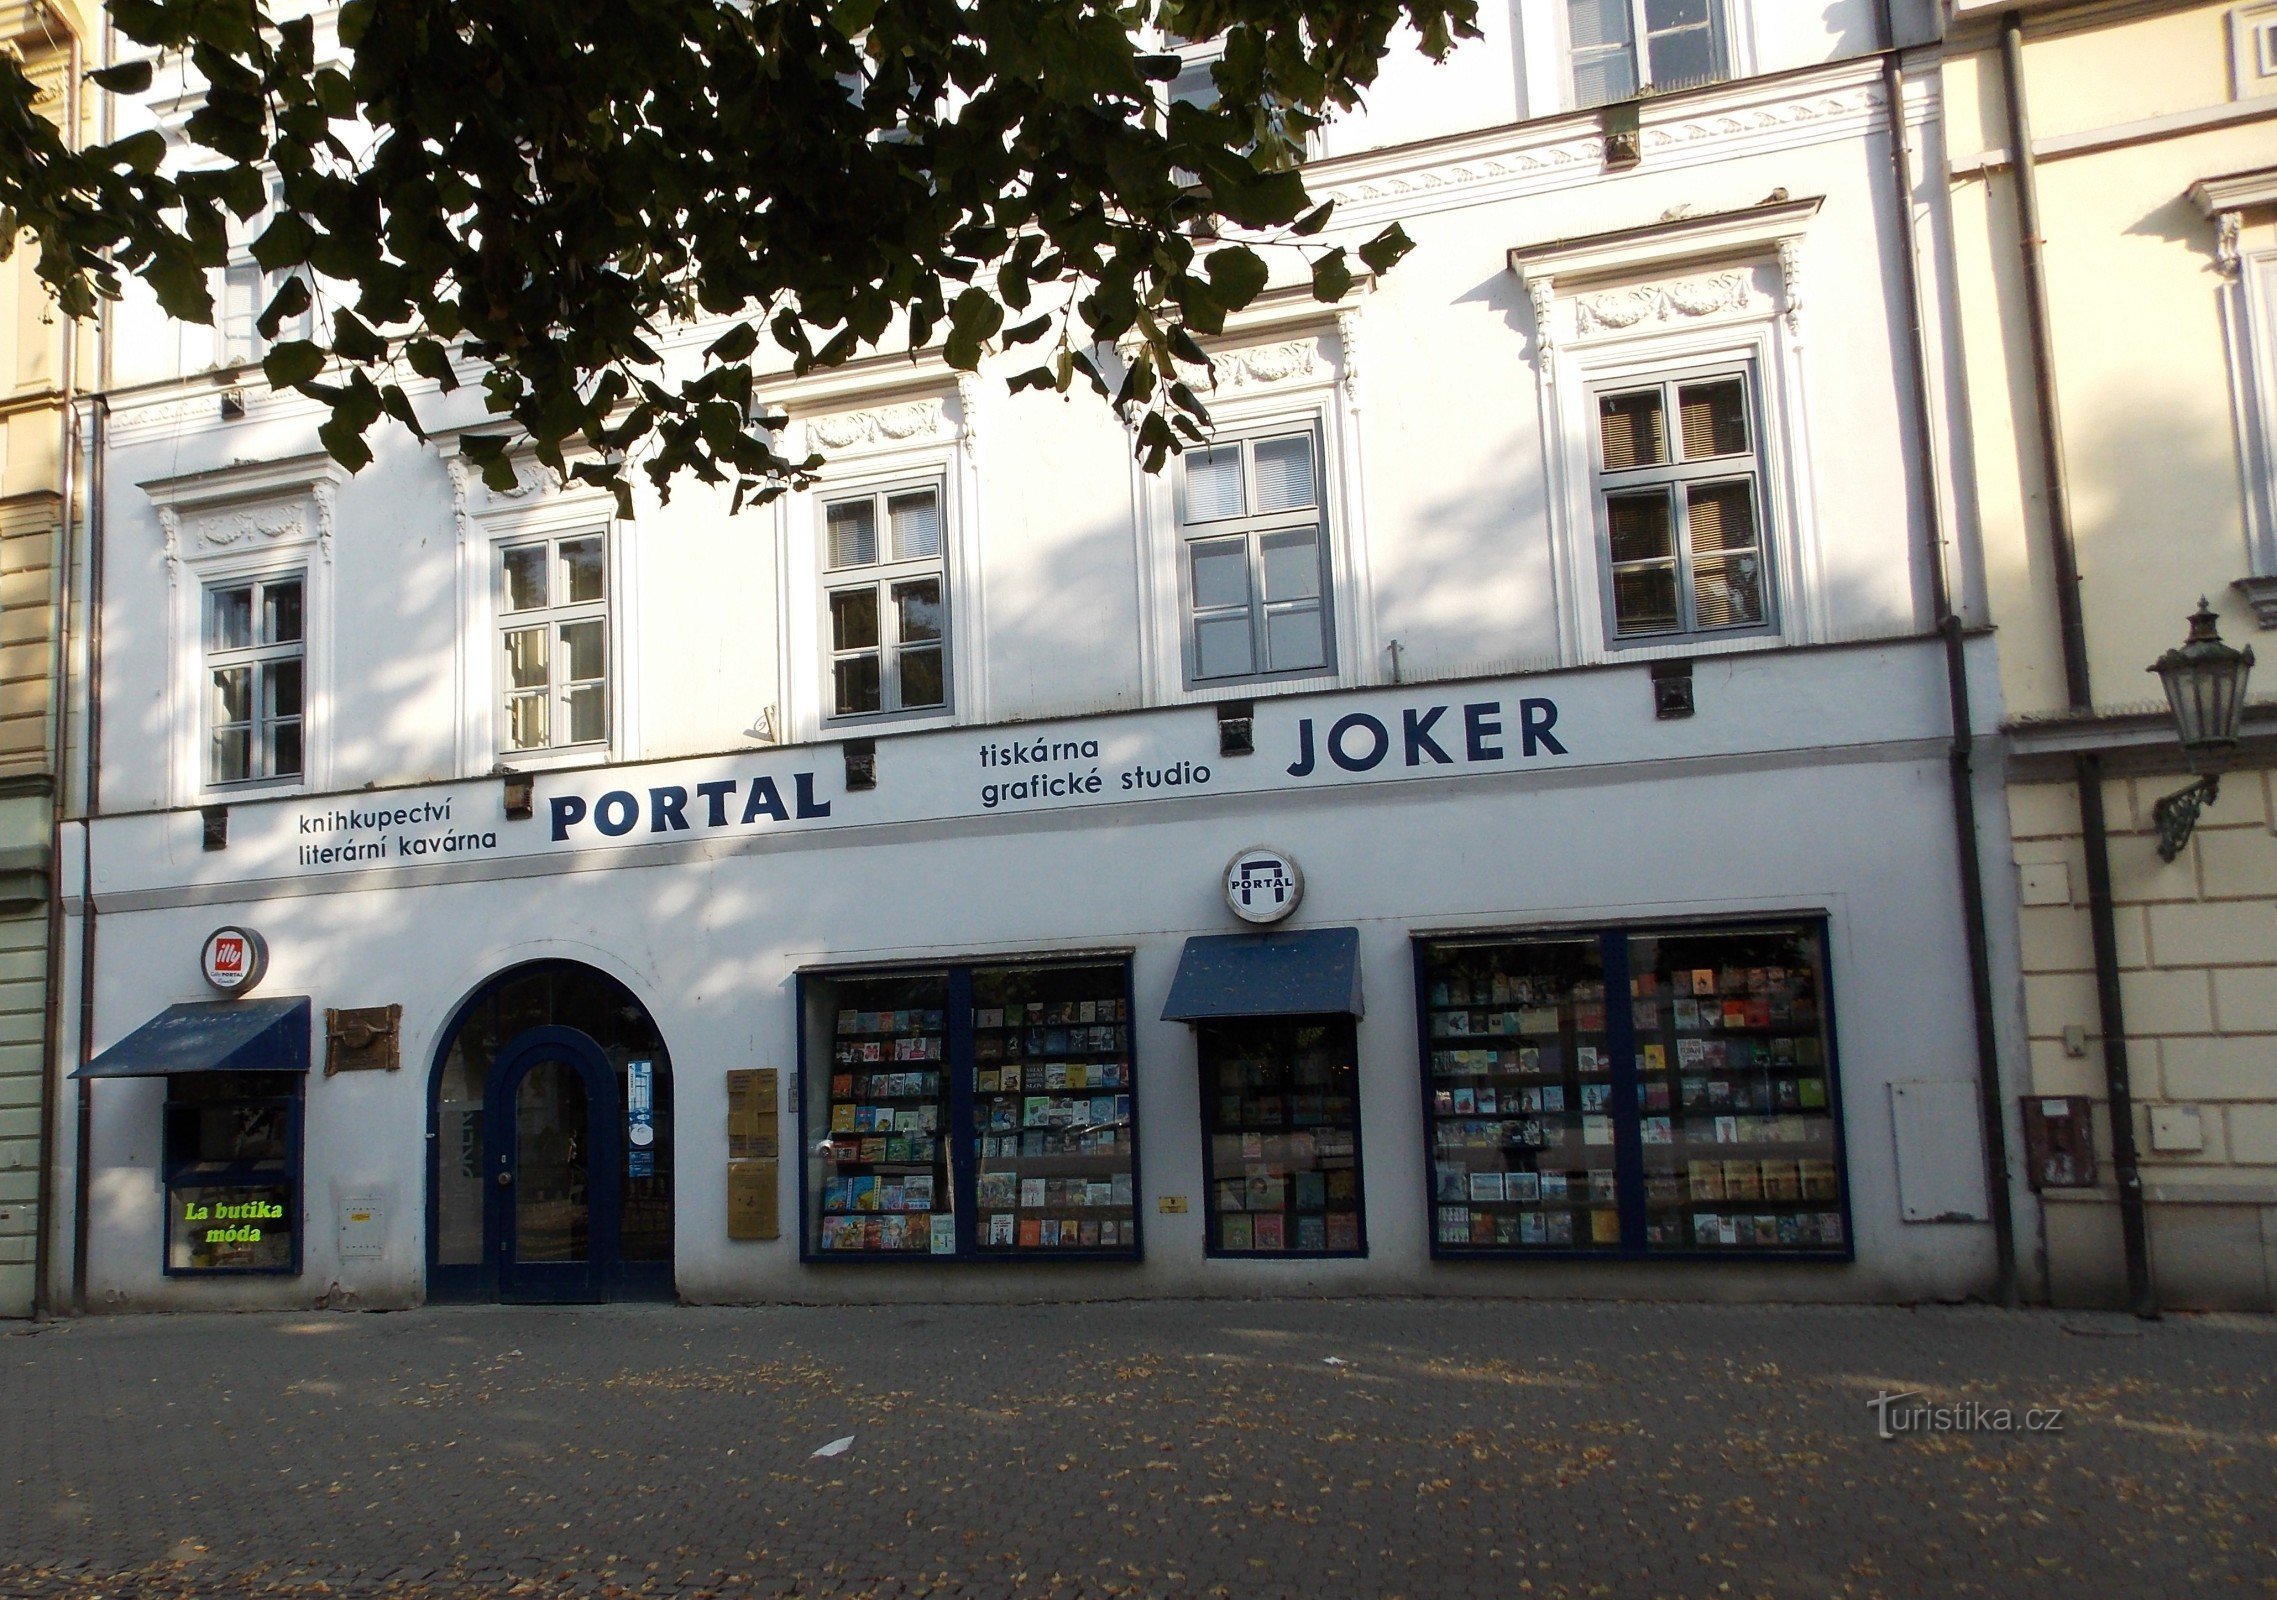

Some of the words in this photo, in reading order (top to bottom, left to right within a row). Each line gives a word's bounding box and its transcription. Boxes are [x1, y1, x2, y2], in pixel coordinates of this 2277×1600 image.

[980, 737, 1099, 767] tiskárna
[1286, 697, 1569, 777] JOKER
[981, 767, 1103, 808] grafické
[1121, 761, 1211, 790] studio
[299, 797, 452, 834] knihkupectví
[548, 772, 831, 842] PORTAL
[299, 835, 387, 865] literární
[399, 829, 496, 856] kavárna
[1231, 877, 1293, 890] PORTAL
[216, 943, 241, 967] illy
[184, 1202, 209, 1220] La
[214, 1200, 283, 1219] butika
[205, 1223, 261, 1243] móda
